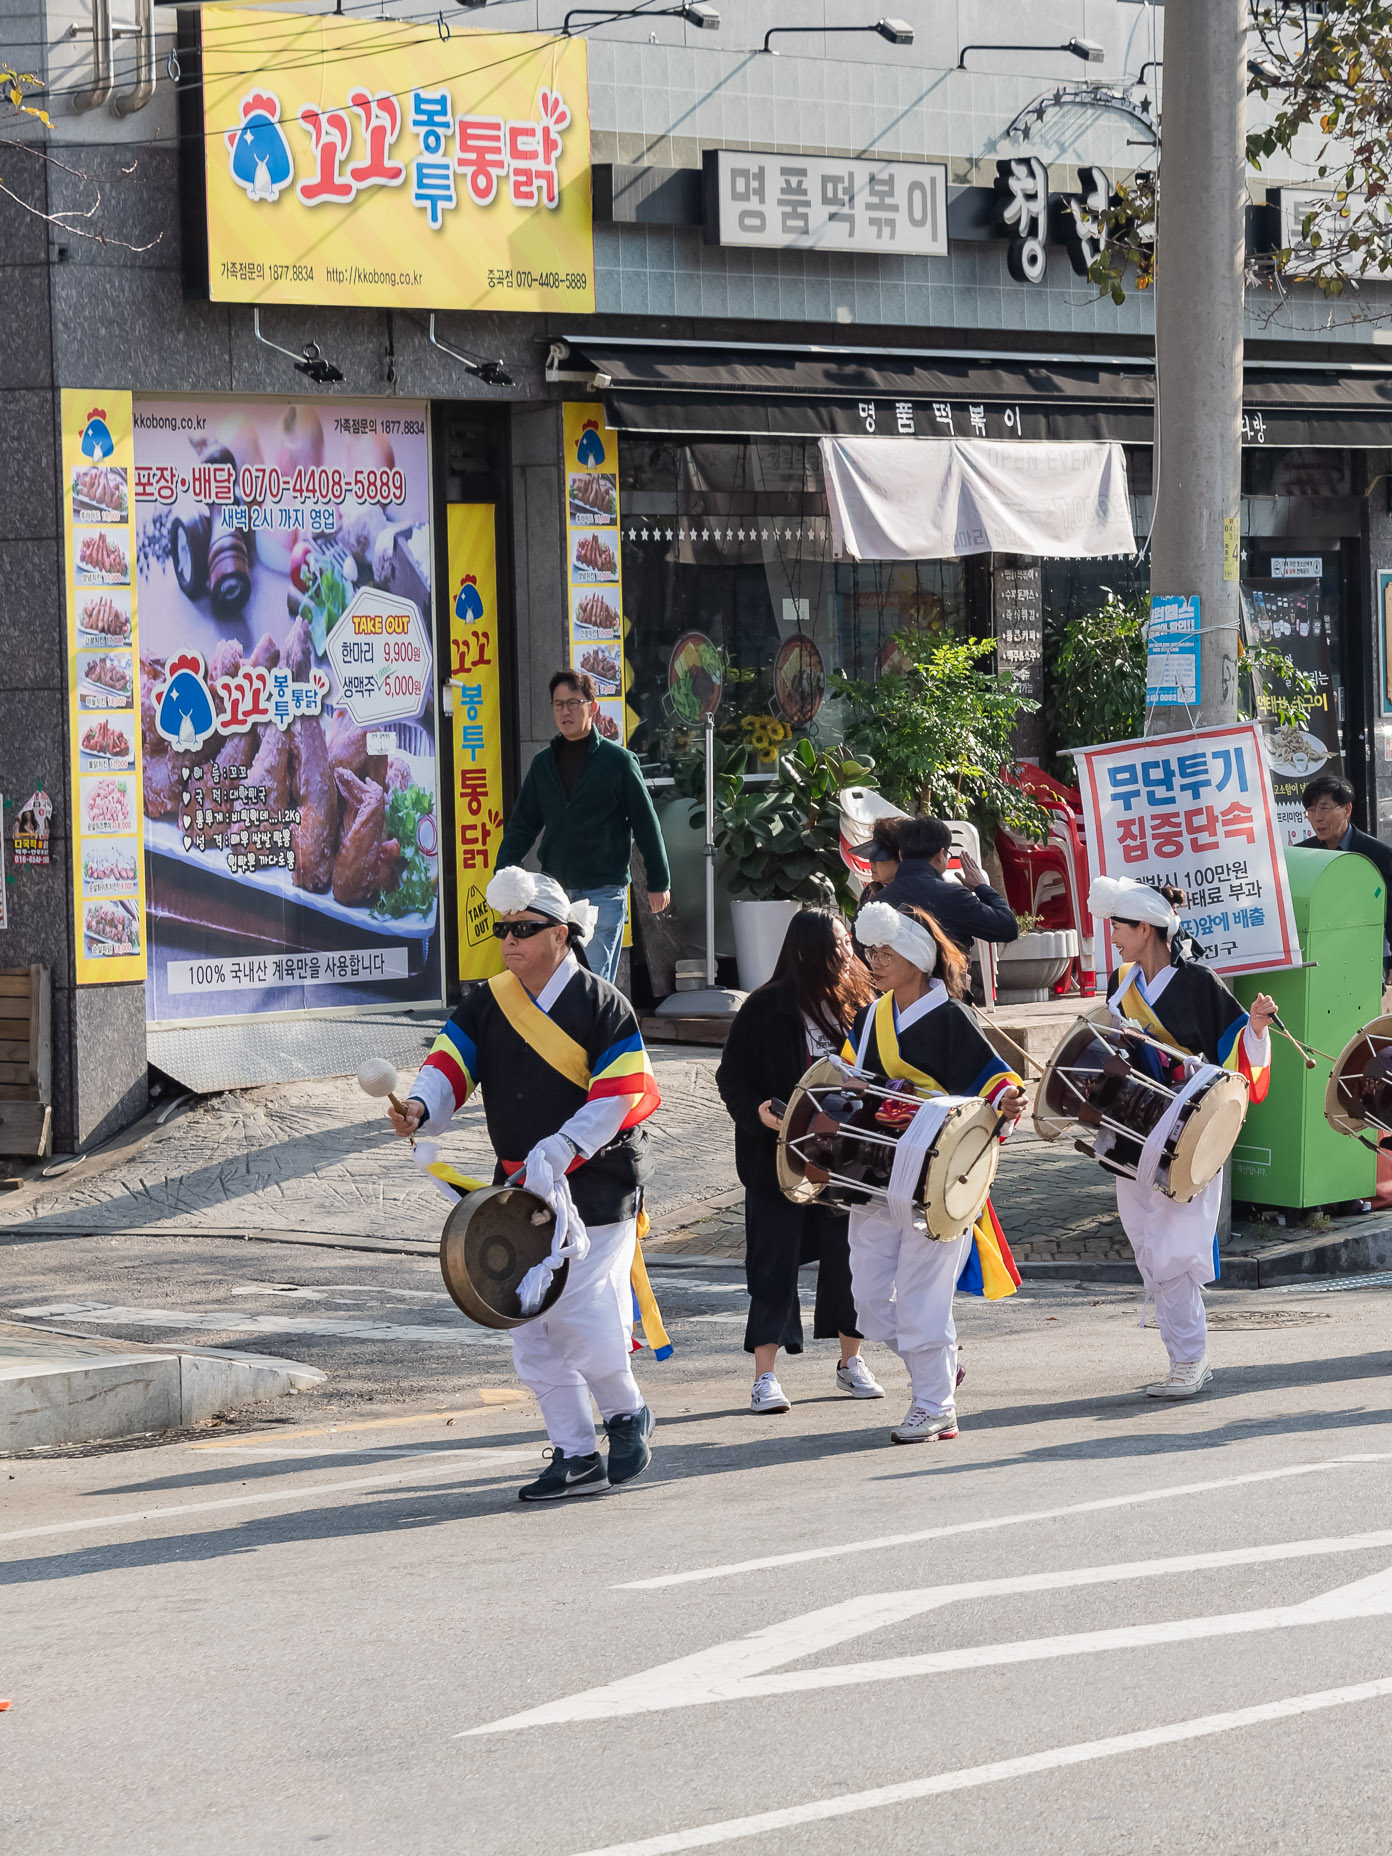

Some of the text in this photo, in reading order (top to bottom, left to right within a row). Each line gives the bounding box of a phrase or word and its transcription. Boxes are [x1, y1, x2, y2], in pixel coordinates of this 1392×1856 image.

[299, 92, 559, 223] 꼬꼬 봉투 통닭
[730, 164, 938, 243] 명품떡볶이
[220, 261, 314, 282] 가족점문의 1877.8834
[326, 266, 423, 288] http://kkobong.co.kr
[486, 268, 588, 290] 중곡점 070-4408-5889
[133, 413, 207, 432] kkobong.co.kr
[334, 418, 425, 436] 가족점문의 1877.8834
[241, 467, 406, 502] 070-4408-5889
[220, 508, 336, 531] 새벽 2시 까지 영업
[352, 615, 411, 635] TAKE OUT
[341, 641, 421, 665] 한마리 9,900원
[342, 675, 422, 699] 생맥주 5,000원
[220, 672, 319, 728] 꼬꼬 봉투 통닭
[451, 630, 492, 871] 꼬꼬 봉투 통닭
[229, 766, 248, 780] 꼬꼬
[1106, 746, 1250, 812] 무단투기
[229, 785, 267, 804] 대한민국
[1277, 811, 1303, 824] 프리미엄
[230, 829, 249, 847] 매우
[252, 830, 272, 848] 쌀쌀
[1116, 800, 1257, 864] 집중단속
[258, 850, 296, 872] 까다로움
[1184, 860, 1250, 888] 100만원
[1228, 880, 1263, 902] 부과
[467, 898, 489, 926] TAKE
[1233, 907, 1266, 931] 배출
[473, 917, 491, 938] OUT
[188, 953, 385, 985] 100% 국내산 계육만을 사용합니다
